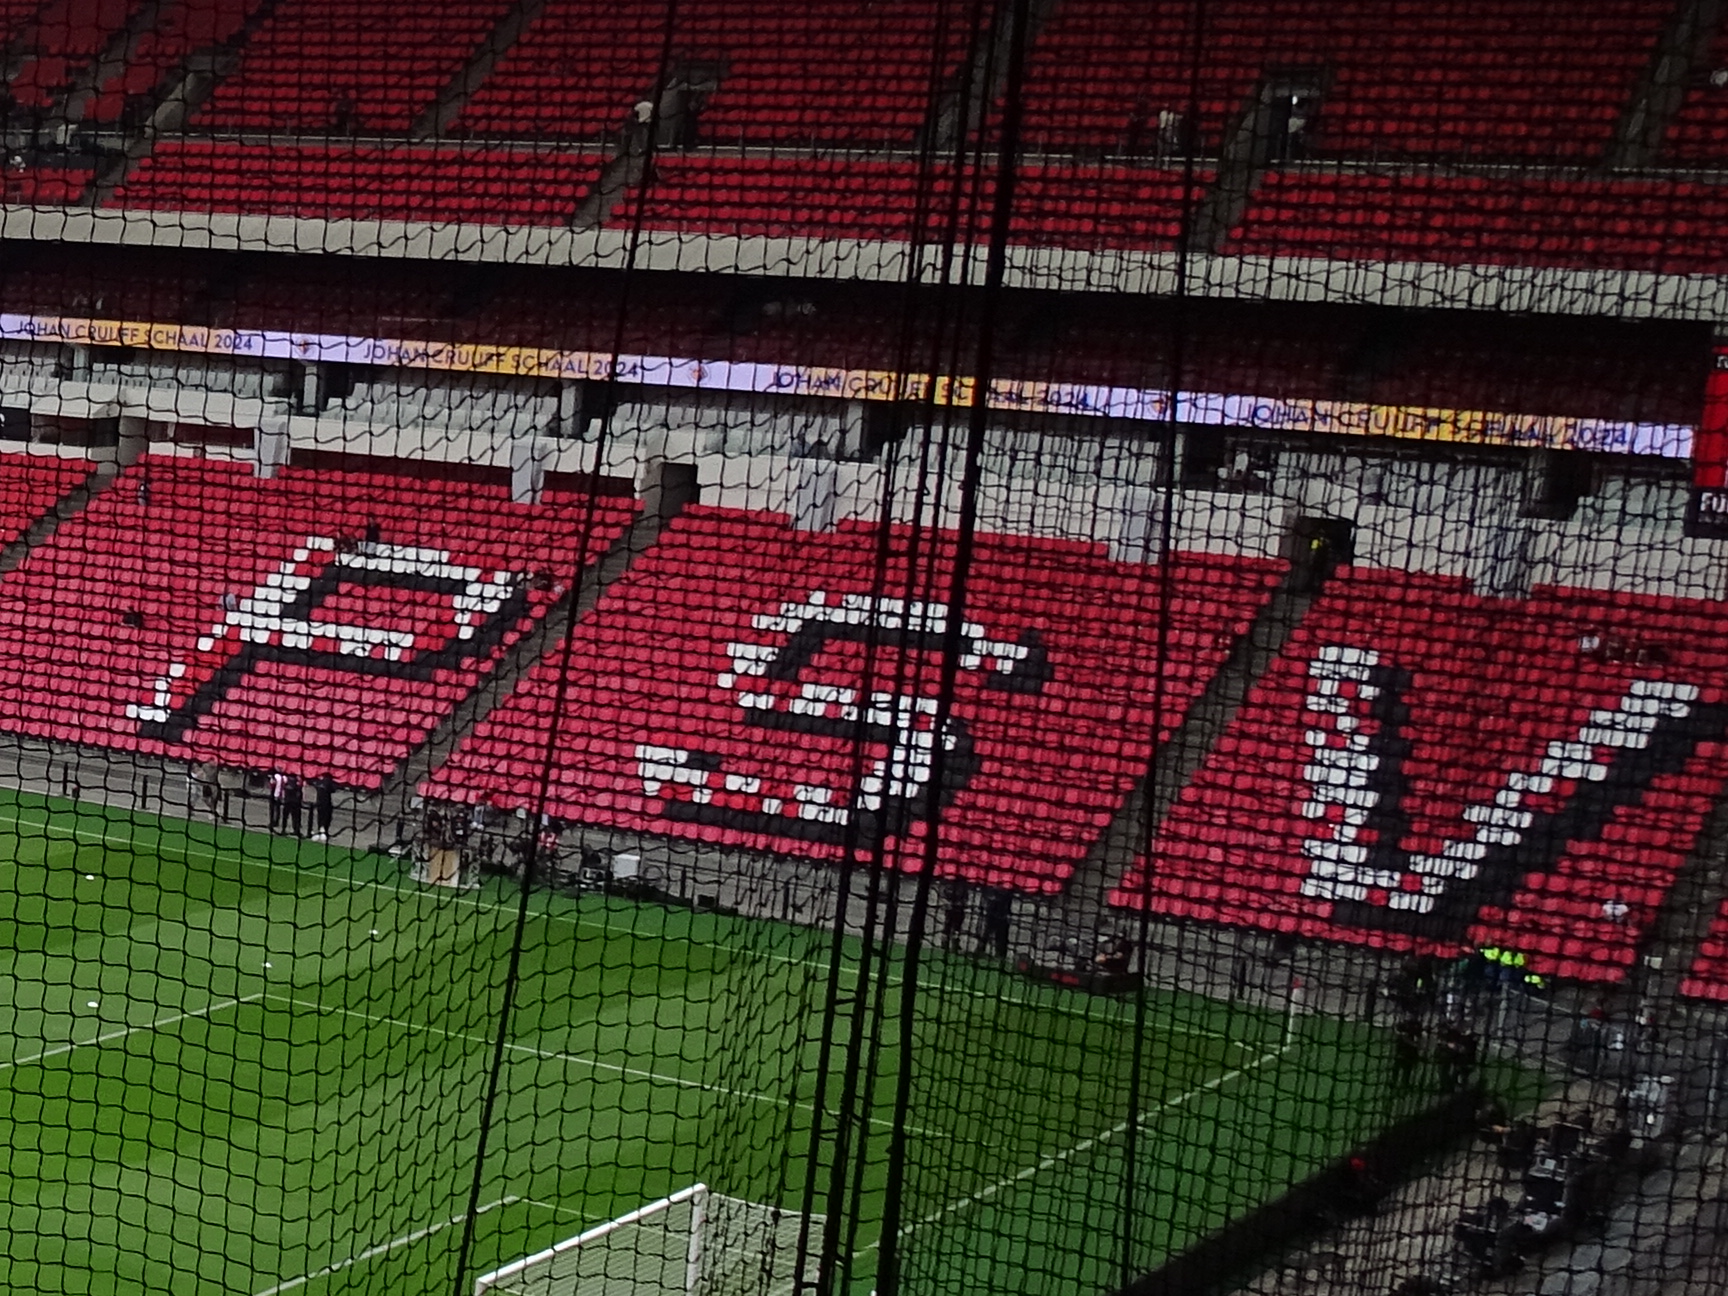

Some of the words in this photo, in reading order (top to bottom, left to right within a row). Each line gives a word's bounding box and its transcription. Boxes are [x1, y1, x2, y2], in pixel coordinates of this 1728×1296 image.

[17, 320, 70, 338] JOHAN
[144, 328, 208, 347] SCHAAL
[214, 333, 253, 351] 2024
[511, 354, 587, 374] SCHAAL
[594, 360, 638, 377] 2024
